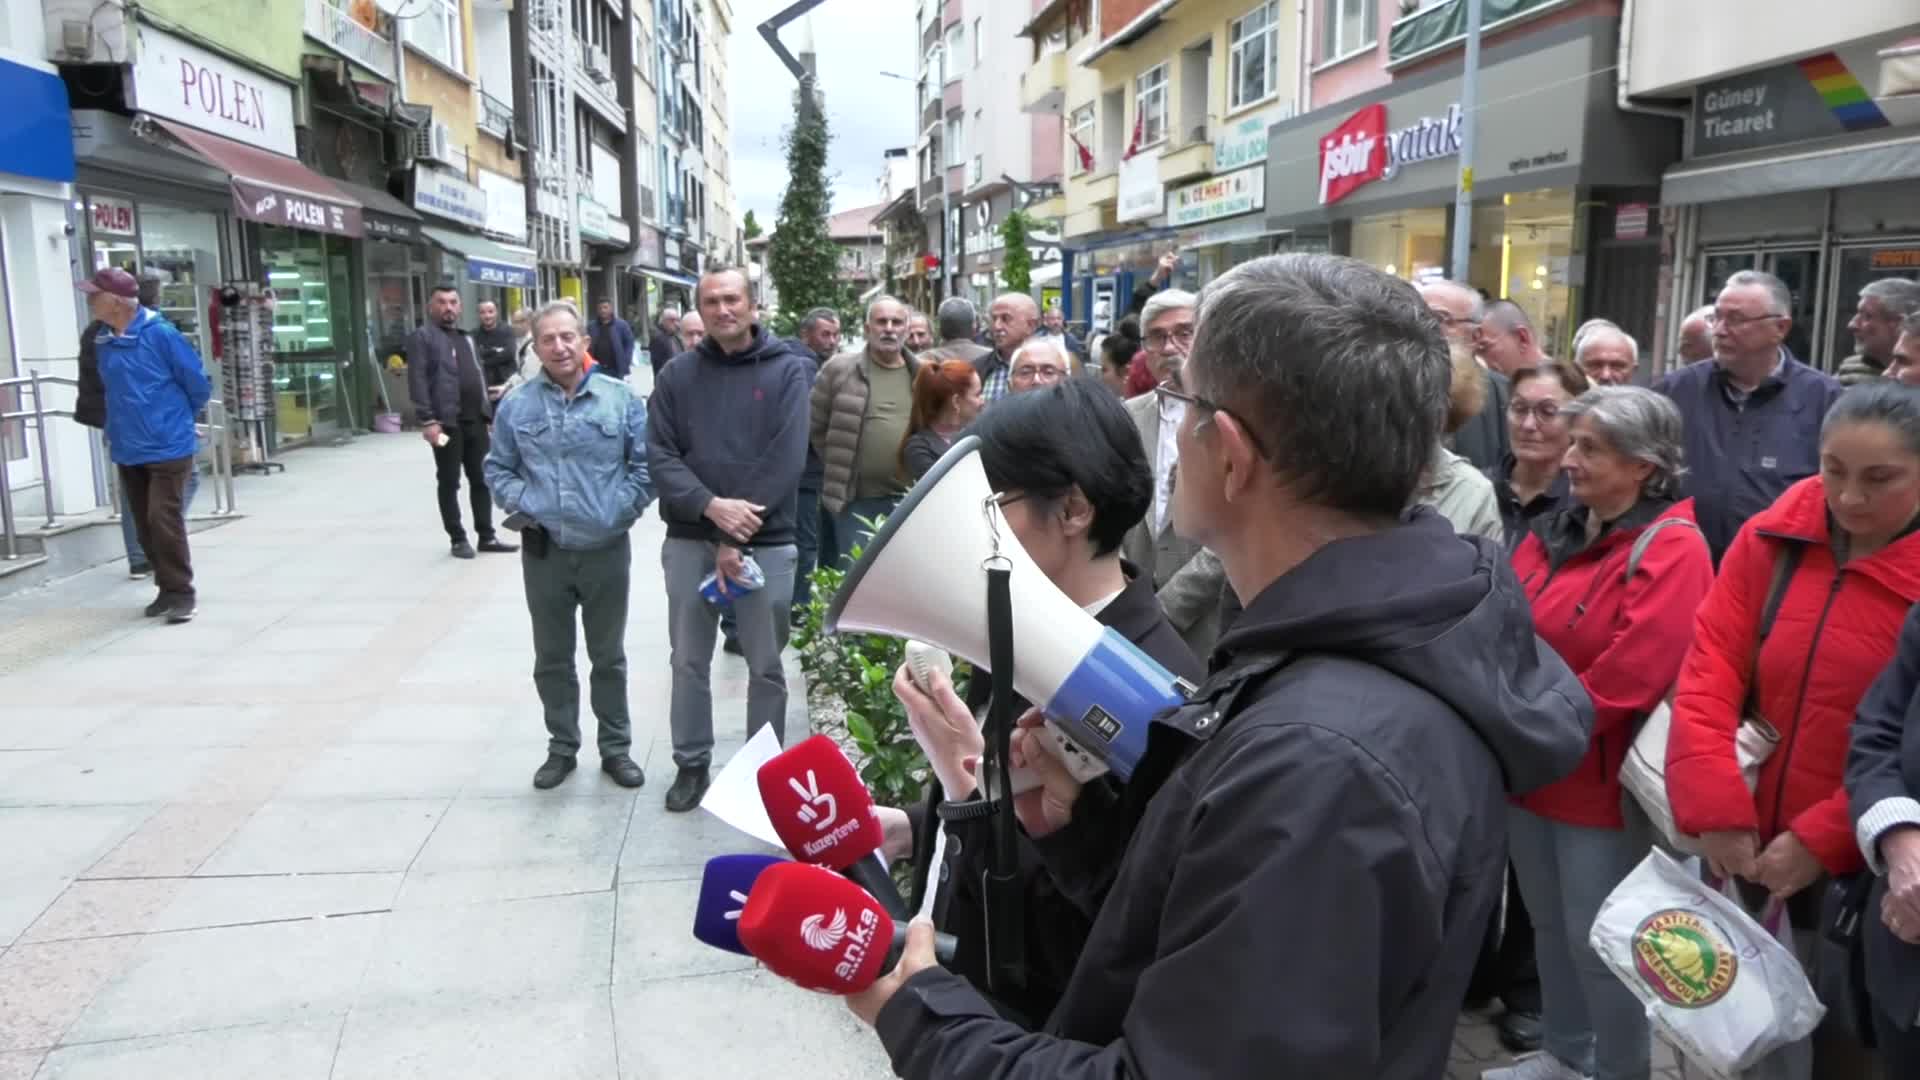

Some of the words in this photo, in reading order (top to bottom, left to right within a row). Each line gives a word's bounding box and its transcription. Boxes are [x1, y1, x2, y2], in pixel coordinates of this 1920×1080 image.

[179, 57, 265, 132] POLEN
[1703, 85, 1768, 113] Güney
[1703, 109, 1774, 139] Ticaret
[1381, 104, 1463, 181] yatak
[95, 202, 132, 231] POLEN
[285, 199, 326, 226] POLEN
[803, 817, 861, 856] Kuzeyteve
[834, 907, 874, 978] anka
